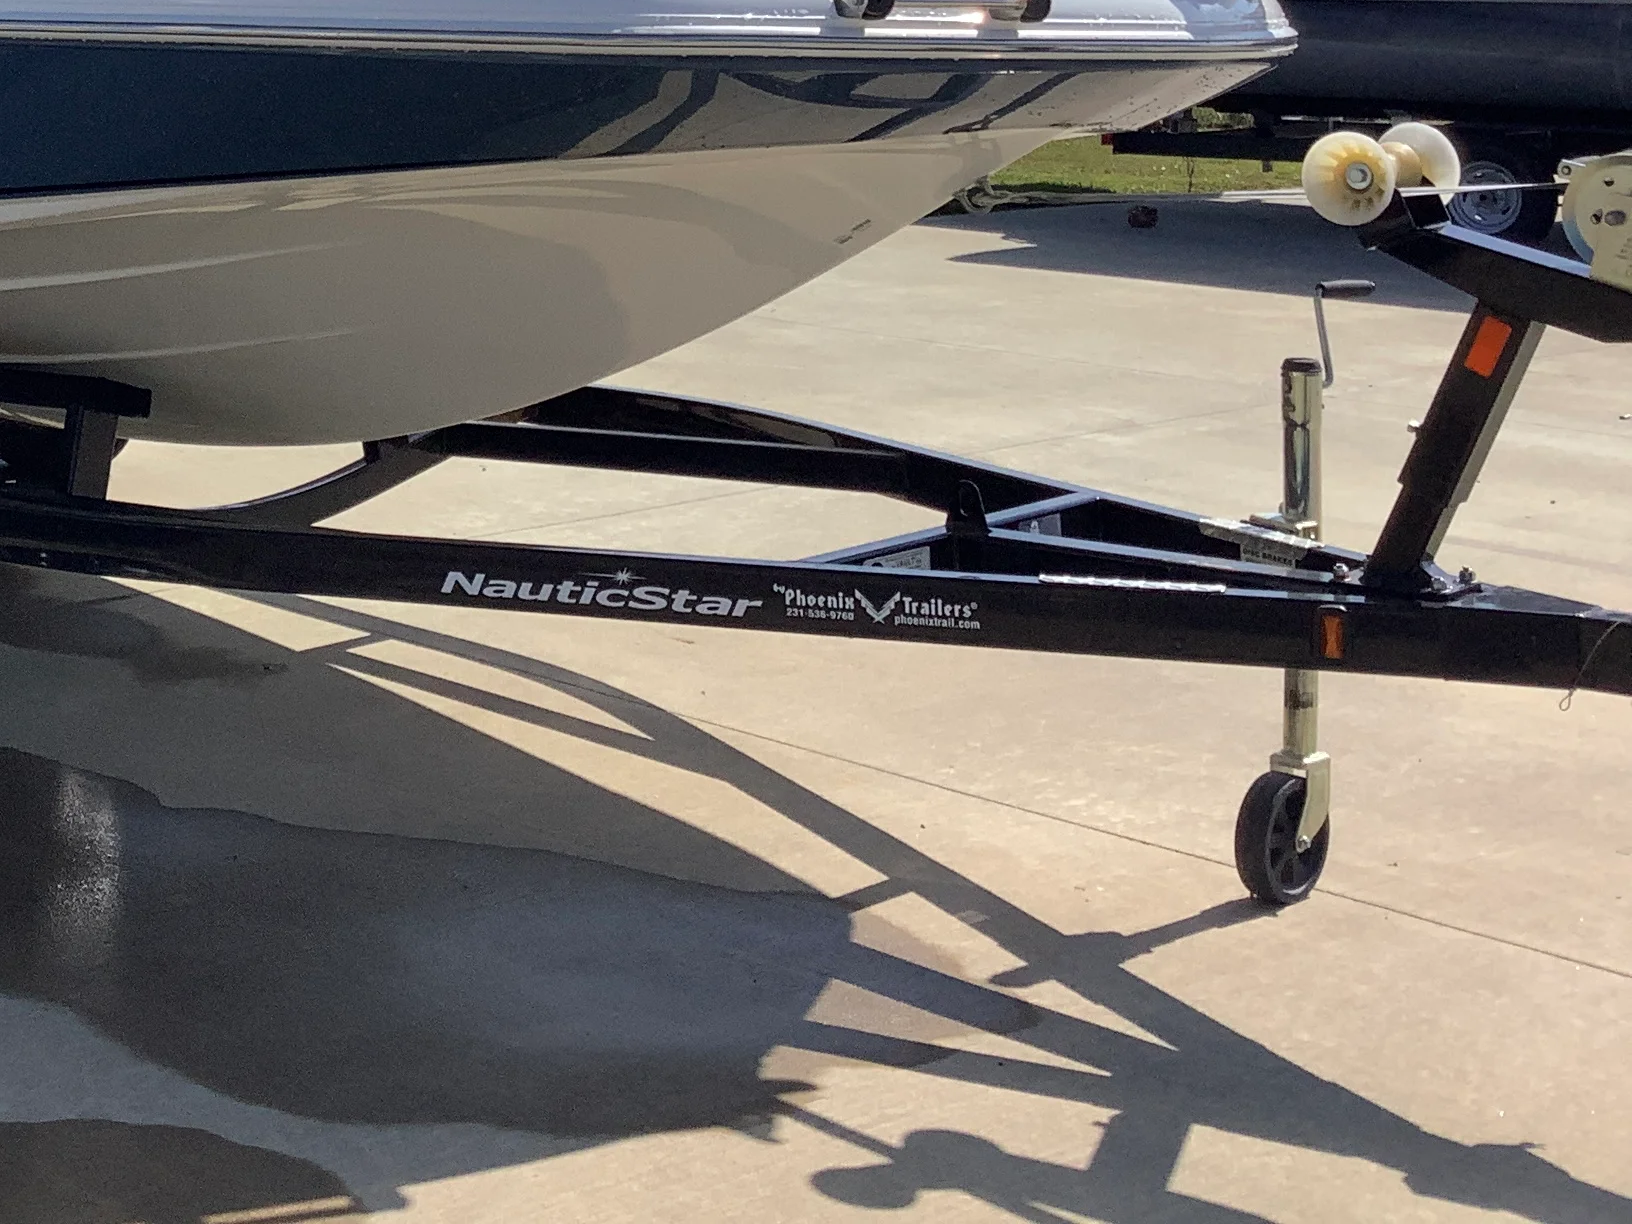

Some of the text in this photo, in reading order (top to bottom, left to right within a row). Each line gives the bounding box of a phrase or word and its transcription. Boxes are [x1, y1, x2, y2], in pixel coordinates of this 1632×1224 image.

[440, 570, 764, 618] NauticStar
[784, 588, 855, 610] Phoenix
[894, 613, 981, 630] phoenixtrail.com
